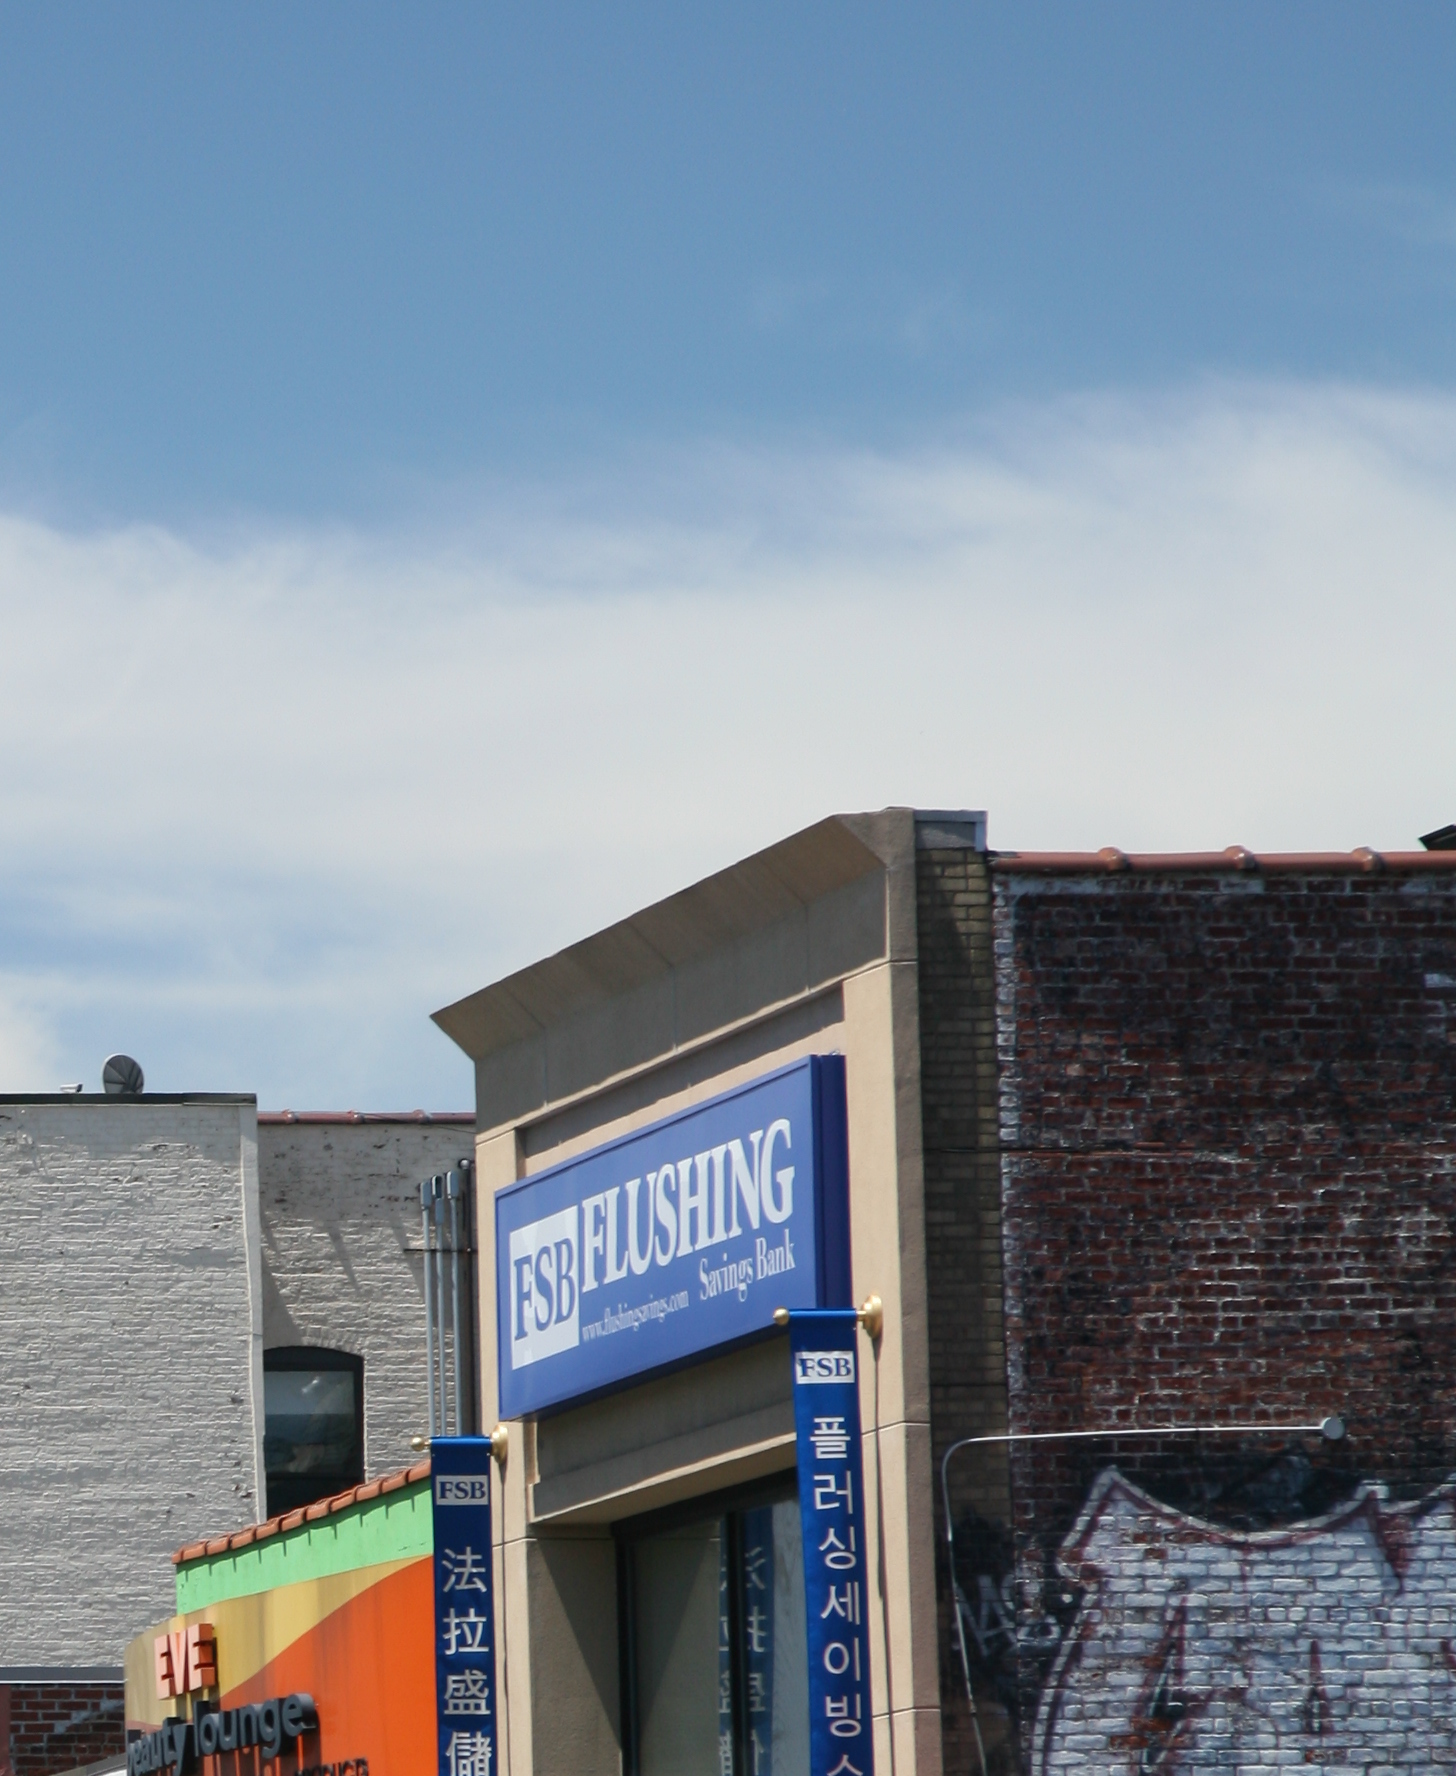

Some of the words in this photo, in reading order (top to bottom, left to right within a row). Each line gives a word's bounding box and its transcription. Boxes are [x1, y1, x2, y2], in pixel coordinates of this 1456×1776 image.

[582, 1118, 795, 1292] FLUSHING
[513, 1238, 576, 1342] FSB
[699, 1253, 754, 1303] Savings
[756, 1229, 796, 1279] Bank
[796, 1357, 852, 1379] FSB
[438, 1480, 487, 1501] FSB
[154, 1623, 216, 1700] EVE
[194, 1693, 317, 1759] lounge
